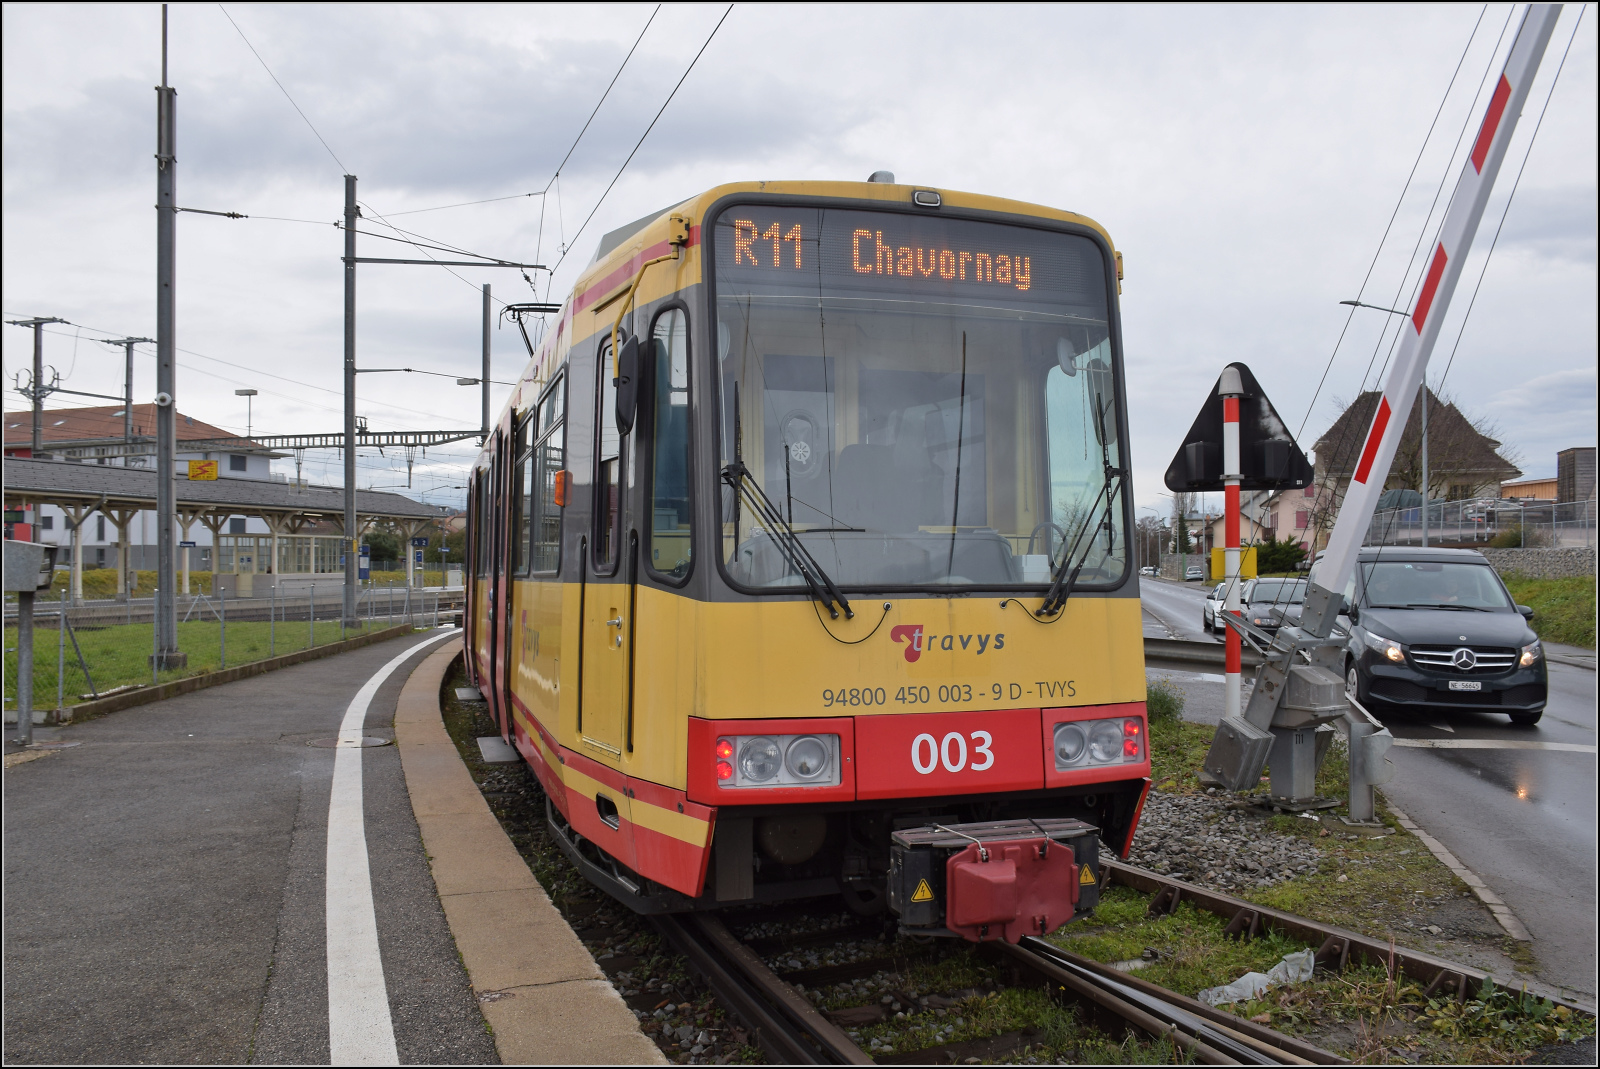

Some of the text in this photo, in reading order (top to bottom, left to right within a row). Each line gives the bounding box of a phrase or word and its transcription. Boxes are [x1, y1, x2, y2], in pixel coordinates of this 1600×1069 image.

[735, 219, 1031, 290] R11 Chavornay
[912, 628, 1005, 655] travys
[822, 687, 886, 707] 94800
[894, 685, 931, 704] 450
[938, 684, 973, 702] 003
[991, 683, 1002, 701] 9
[910, 730, 995, 775] 003
